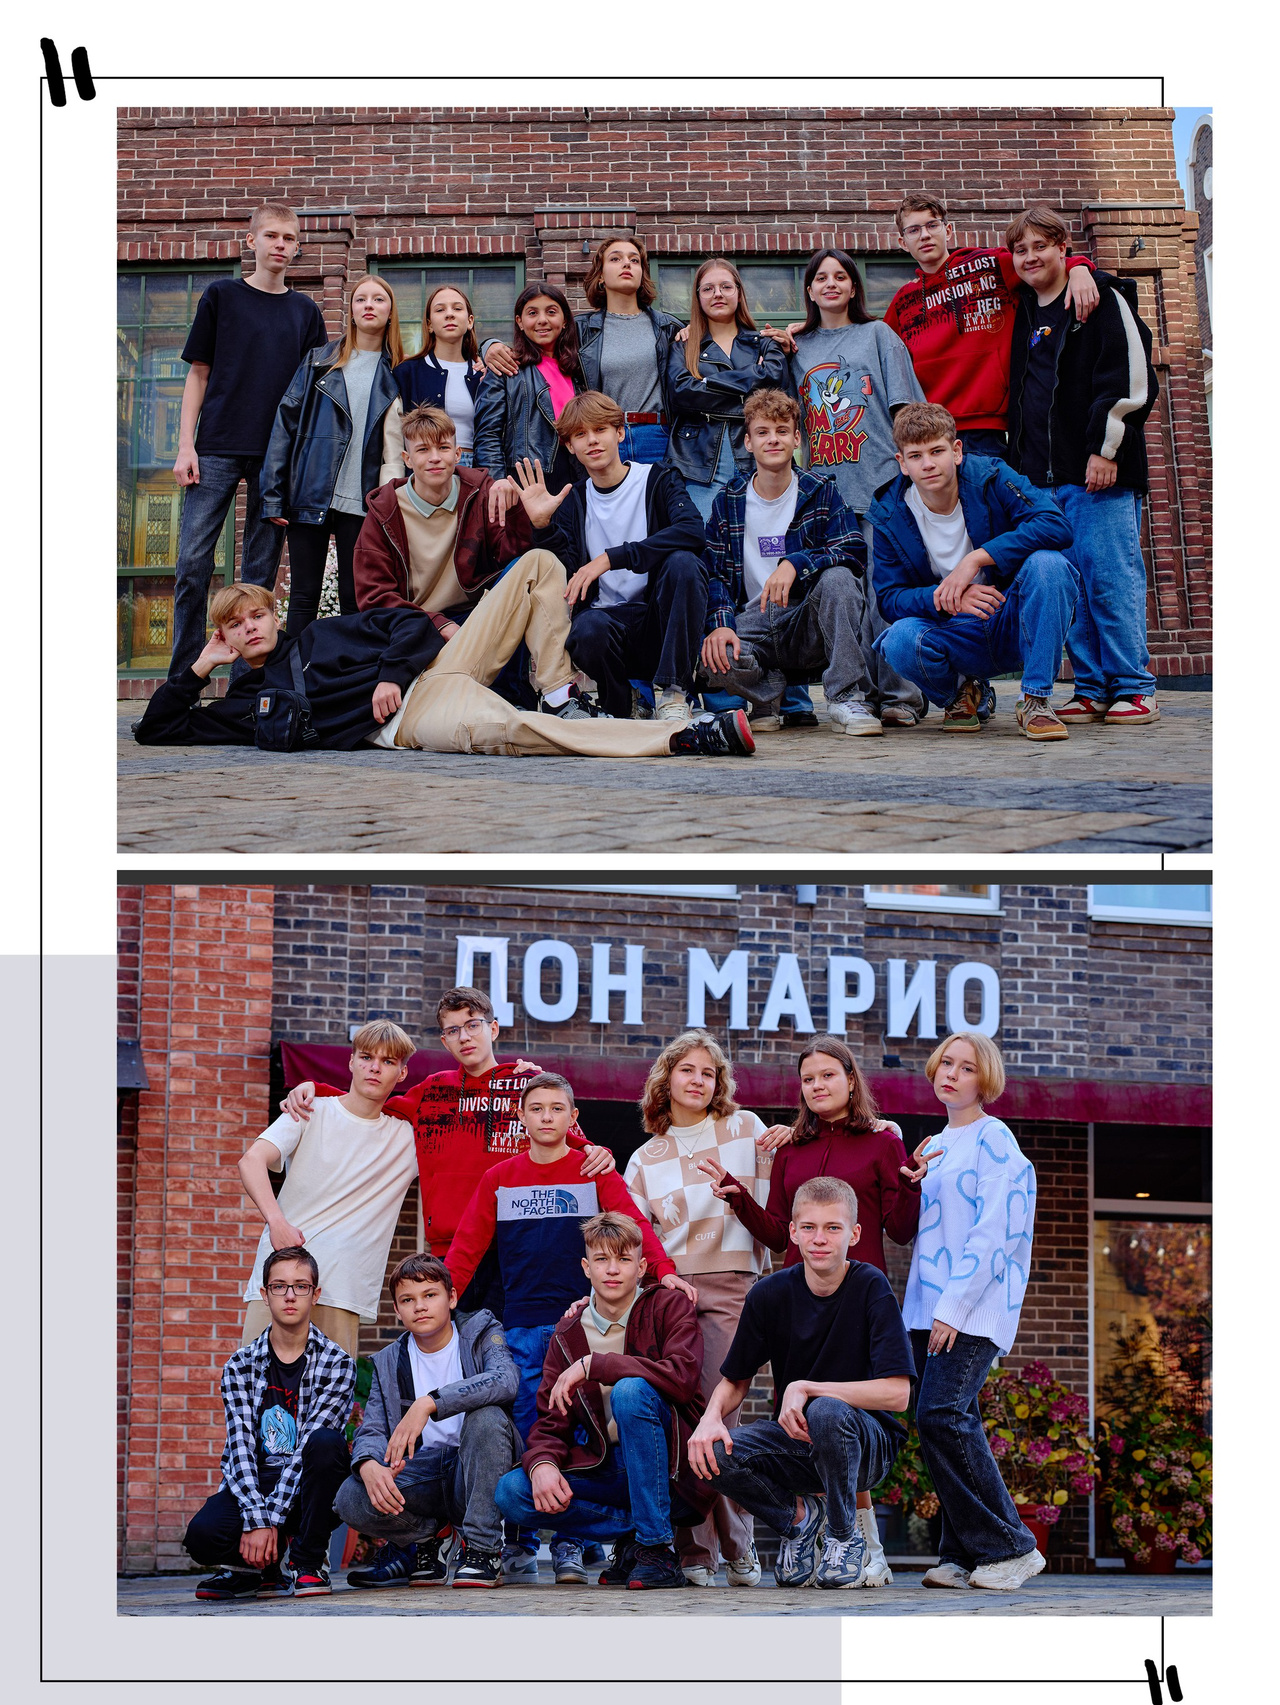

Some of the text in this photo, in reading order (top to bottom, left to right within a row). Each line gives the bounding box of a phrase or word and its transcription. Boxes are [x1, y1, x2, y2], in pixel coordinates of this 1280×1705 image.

[968, 256, 996, 273] LOST
[925, 281, 973, 310] DIVISION
[804, 404, 832, 436] OM
[809, 430, 868, 466] ERRY
[686, 947, 1000, 1039] МАРИО
[531, 1189, 555, 1199] THE
[511, 1198, 554, 1209] NORTH
[523, 1206, 553, 1216] FACE
[695, 1231, 716, 1240] CUTE
